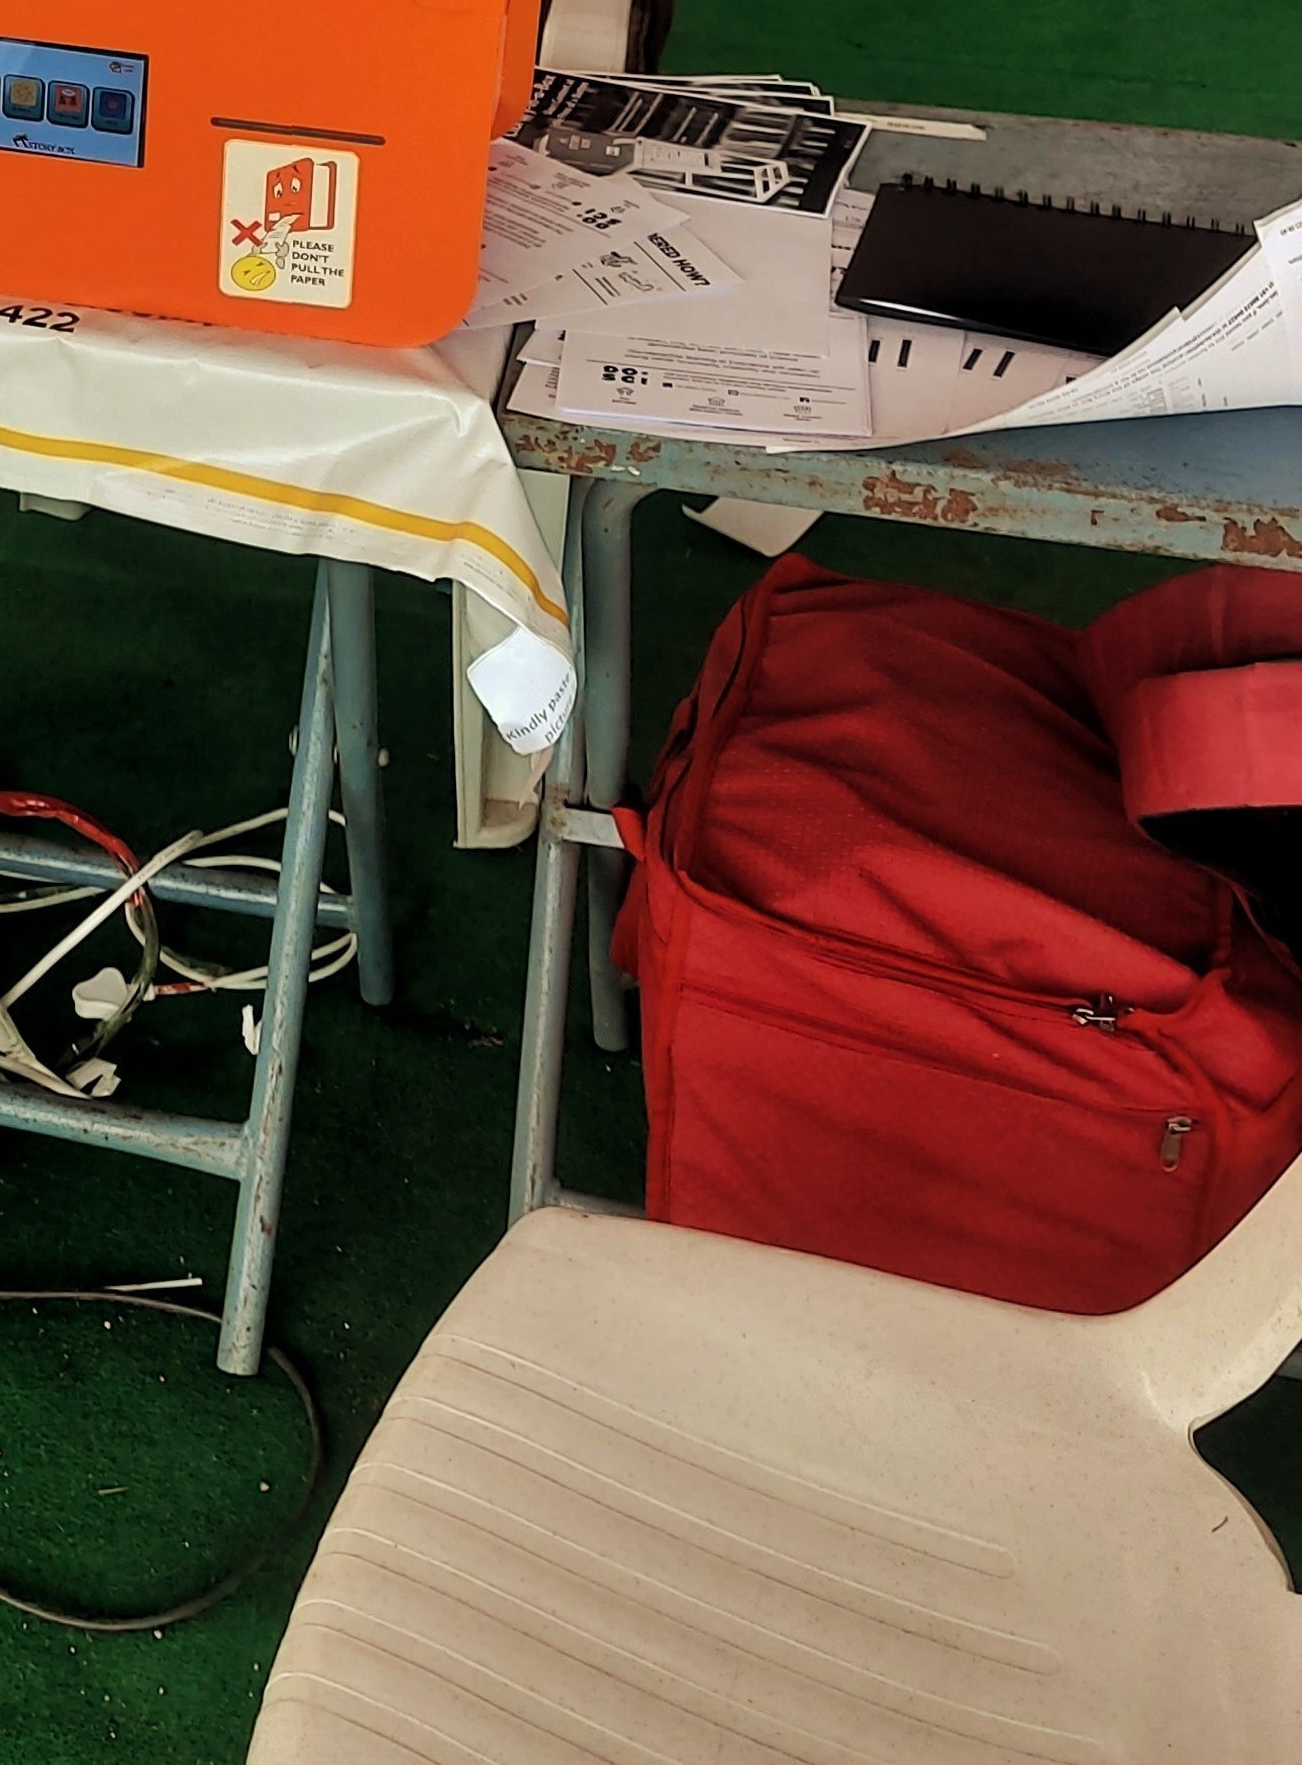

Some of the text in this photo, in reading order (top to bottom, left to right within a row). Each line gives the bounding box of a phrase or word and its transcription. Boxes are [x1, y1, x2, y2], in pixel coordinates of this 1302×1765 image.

[293, 240, 334, 252] PLEASE
[292, 252, 329, 263] DON'T
[291, 263, 344, 277] PULL THE
[291, 274, 325, 286] PAPER
[506, 709, 548, 741] Kindly
